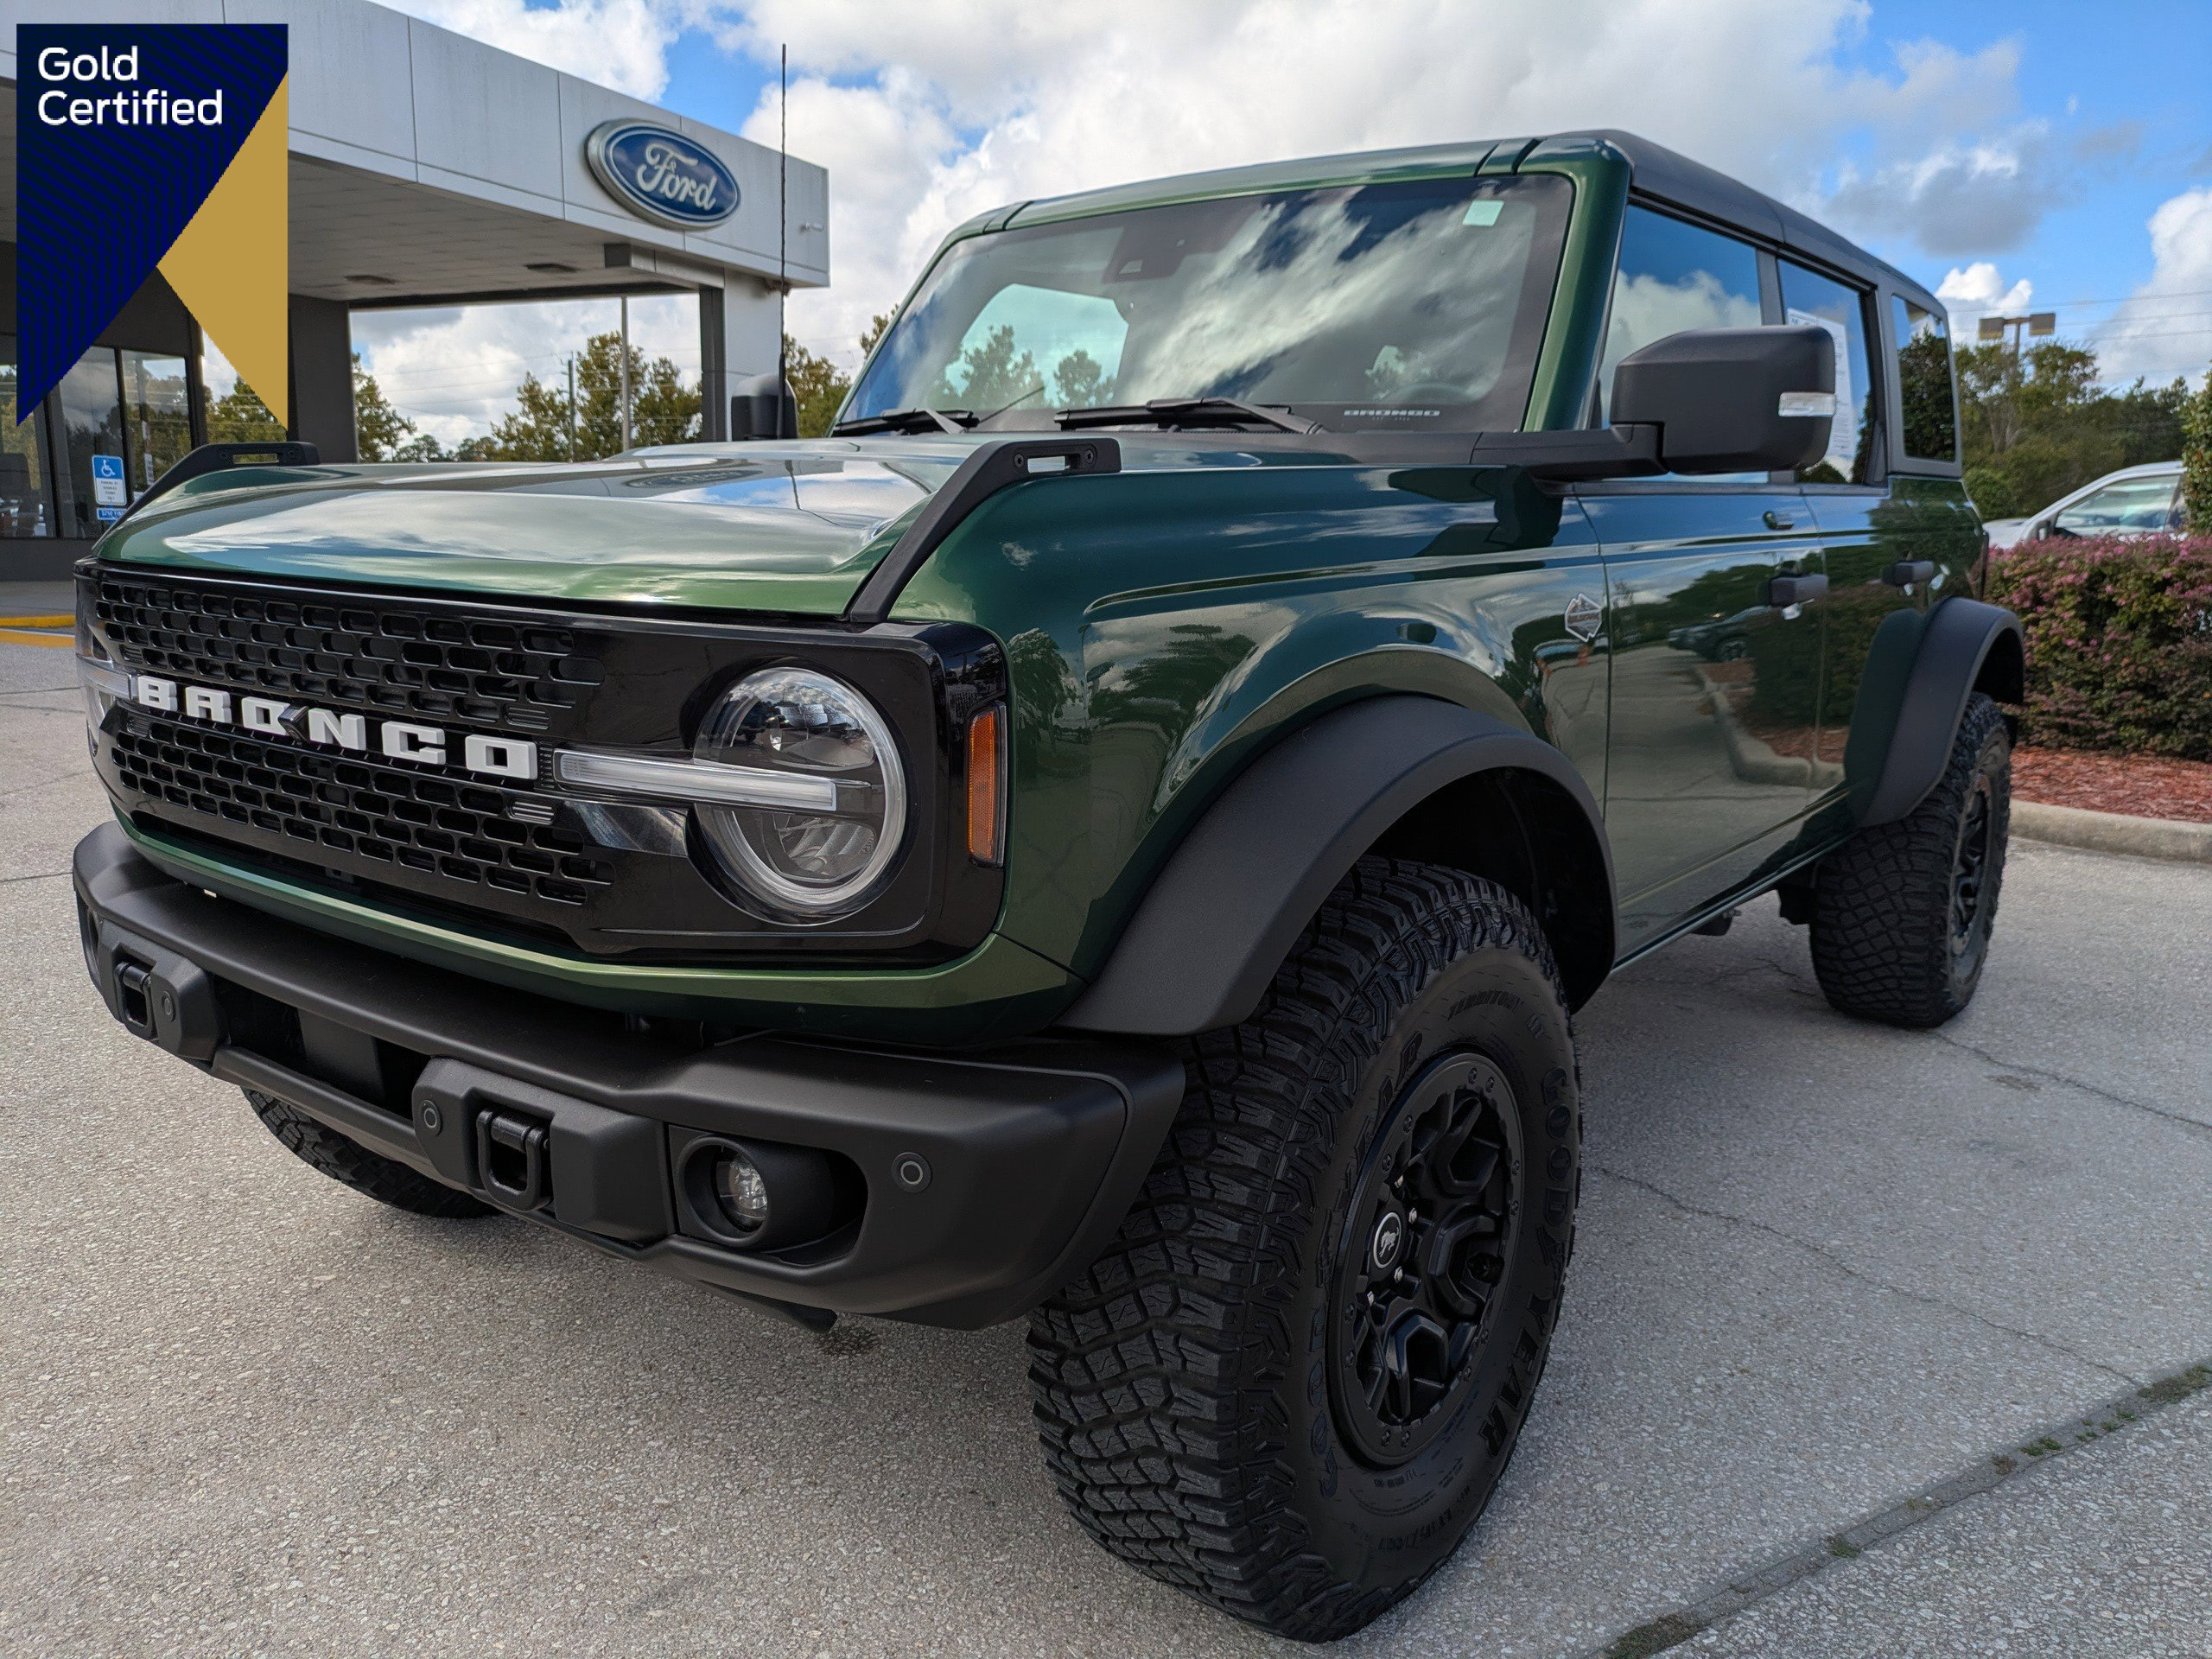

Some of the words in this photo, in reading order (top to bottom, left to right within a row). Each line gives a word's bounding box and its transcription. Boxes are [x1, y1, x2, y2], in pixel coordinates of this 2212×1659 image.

[636, 143, 718, 211] Ford
[137, 674, 537, 780] BRONCO
[1478, 1065, 1572, 1456] GOODYEAR
